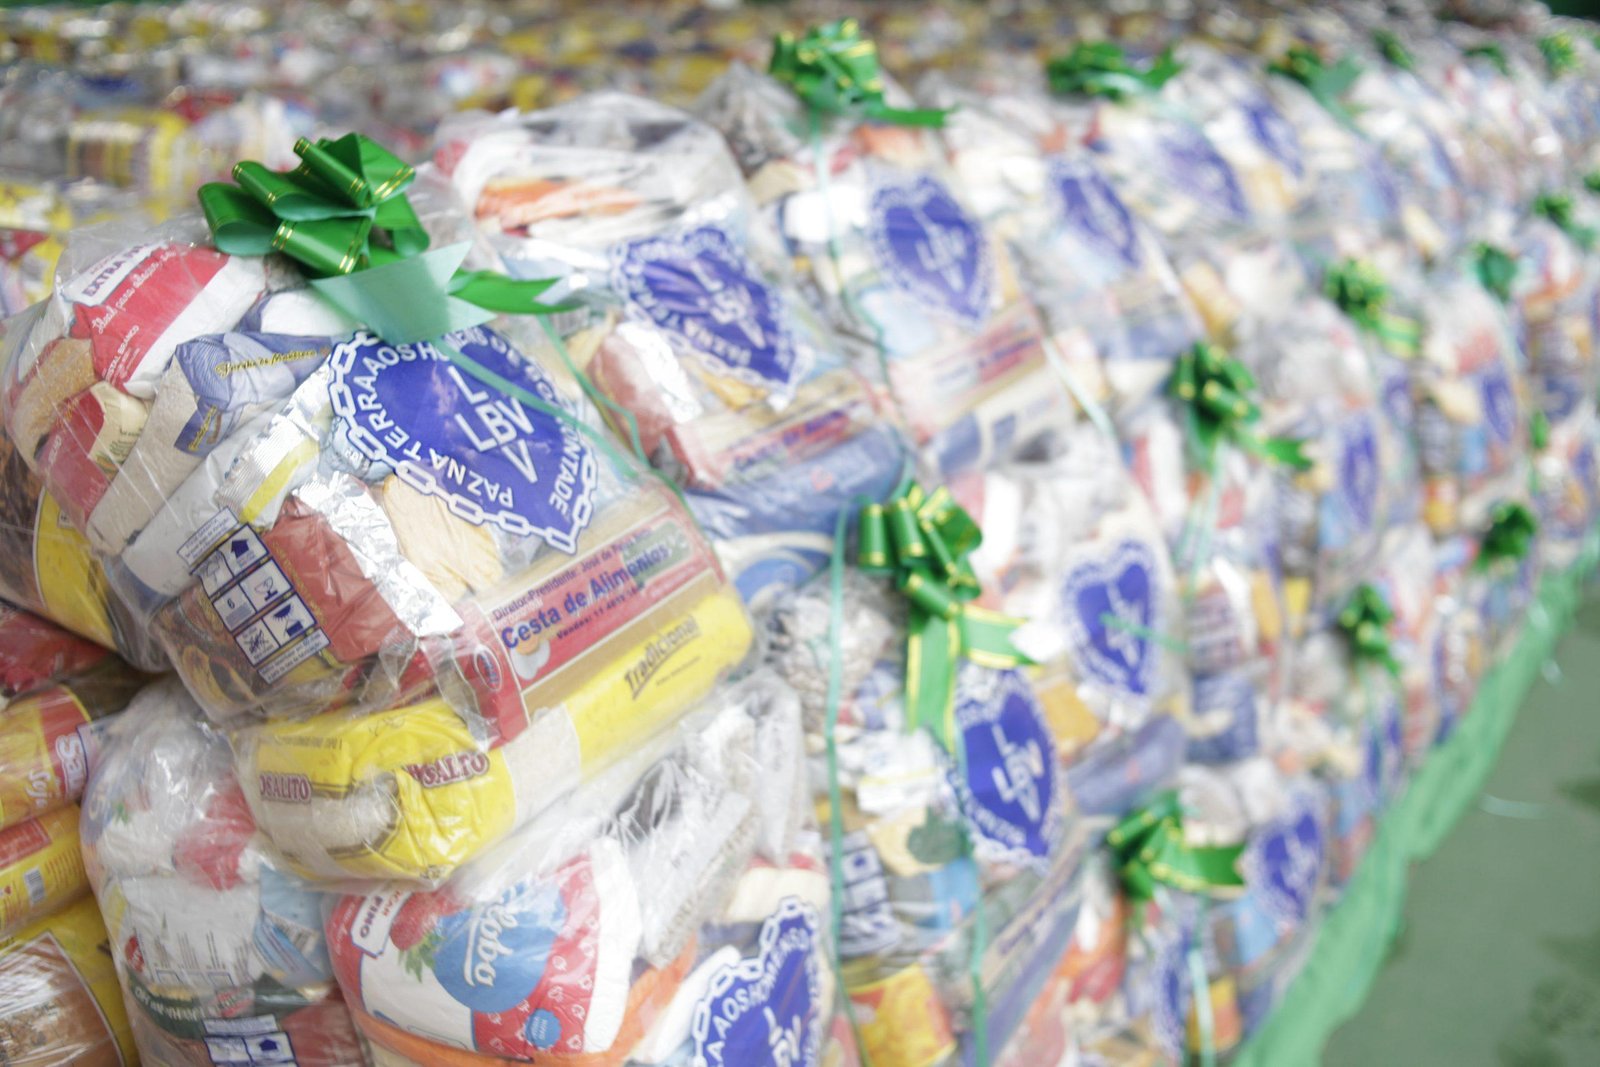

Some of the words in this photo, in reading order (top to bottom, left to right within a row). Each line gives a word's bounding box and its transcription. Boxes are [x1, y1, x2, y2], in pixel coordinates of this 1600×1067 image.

[82, 259, 126, 297] EXTRA
[118, 325, 141, 354] BRANCO
[363, 343, 417, 377] AOS
[353, 375, 422, 462] TERRA
[429, 447, 467, 485] NA
[467, 469, 514, 509] PAZ
[501, 606, 561, 650] Cesta
[564, 592, 588, 614] de
[590, 544, 669, 599] Alimentos
[623, 615, 700, 692] Tradicional
